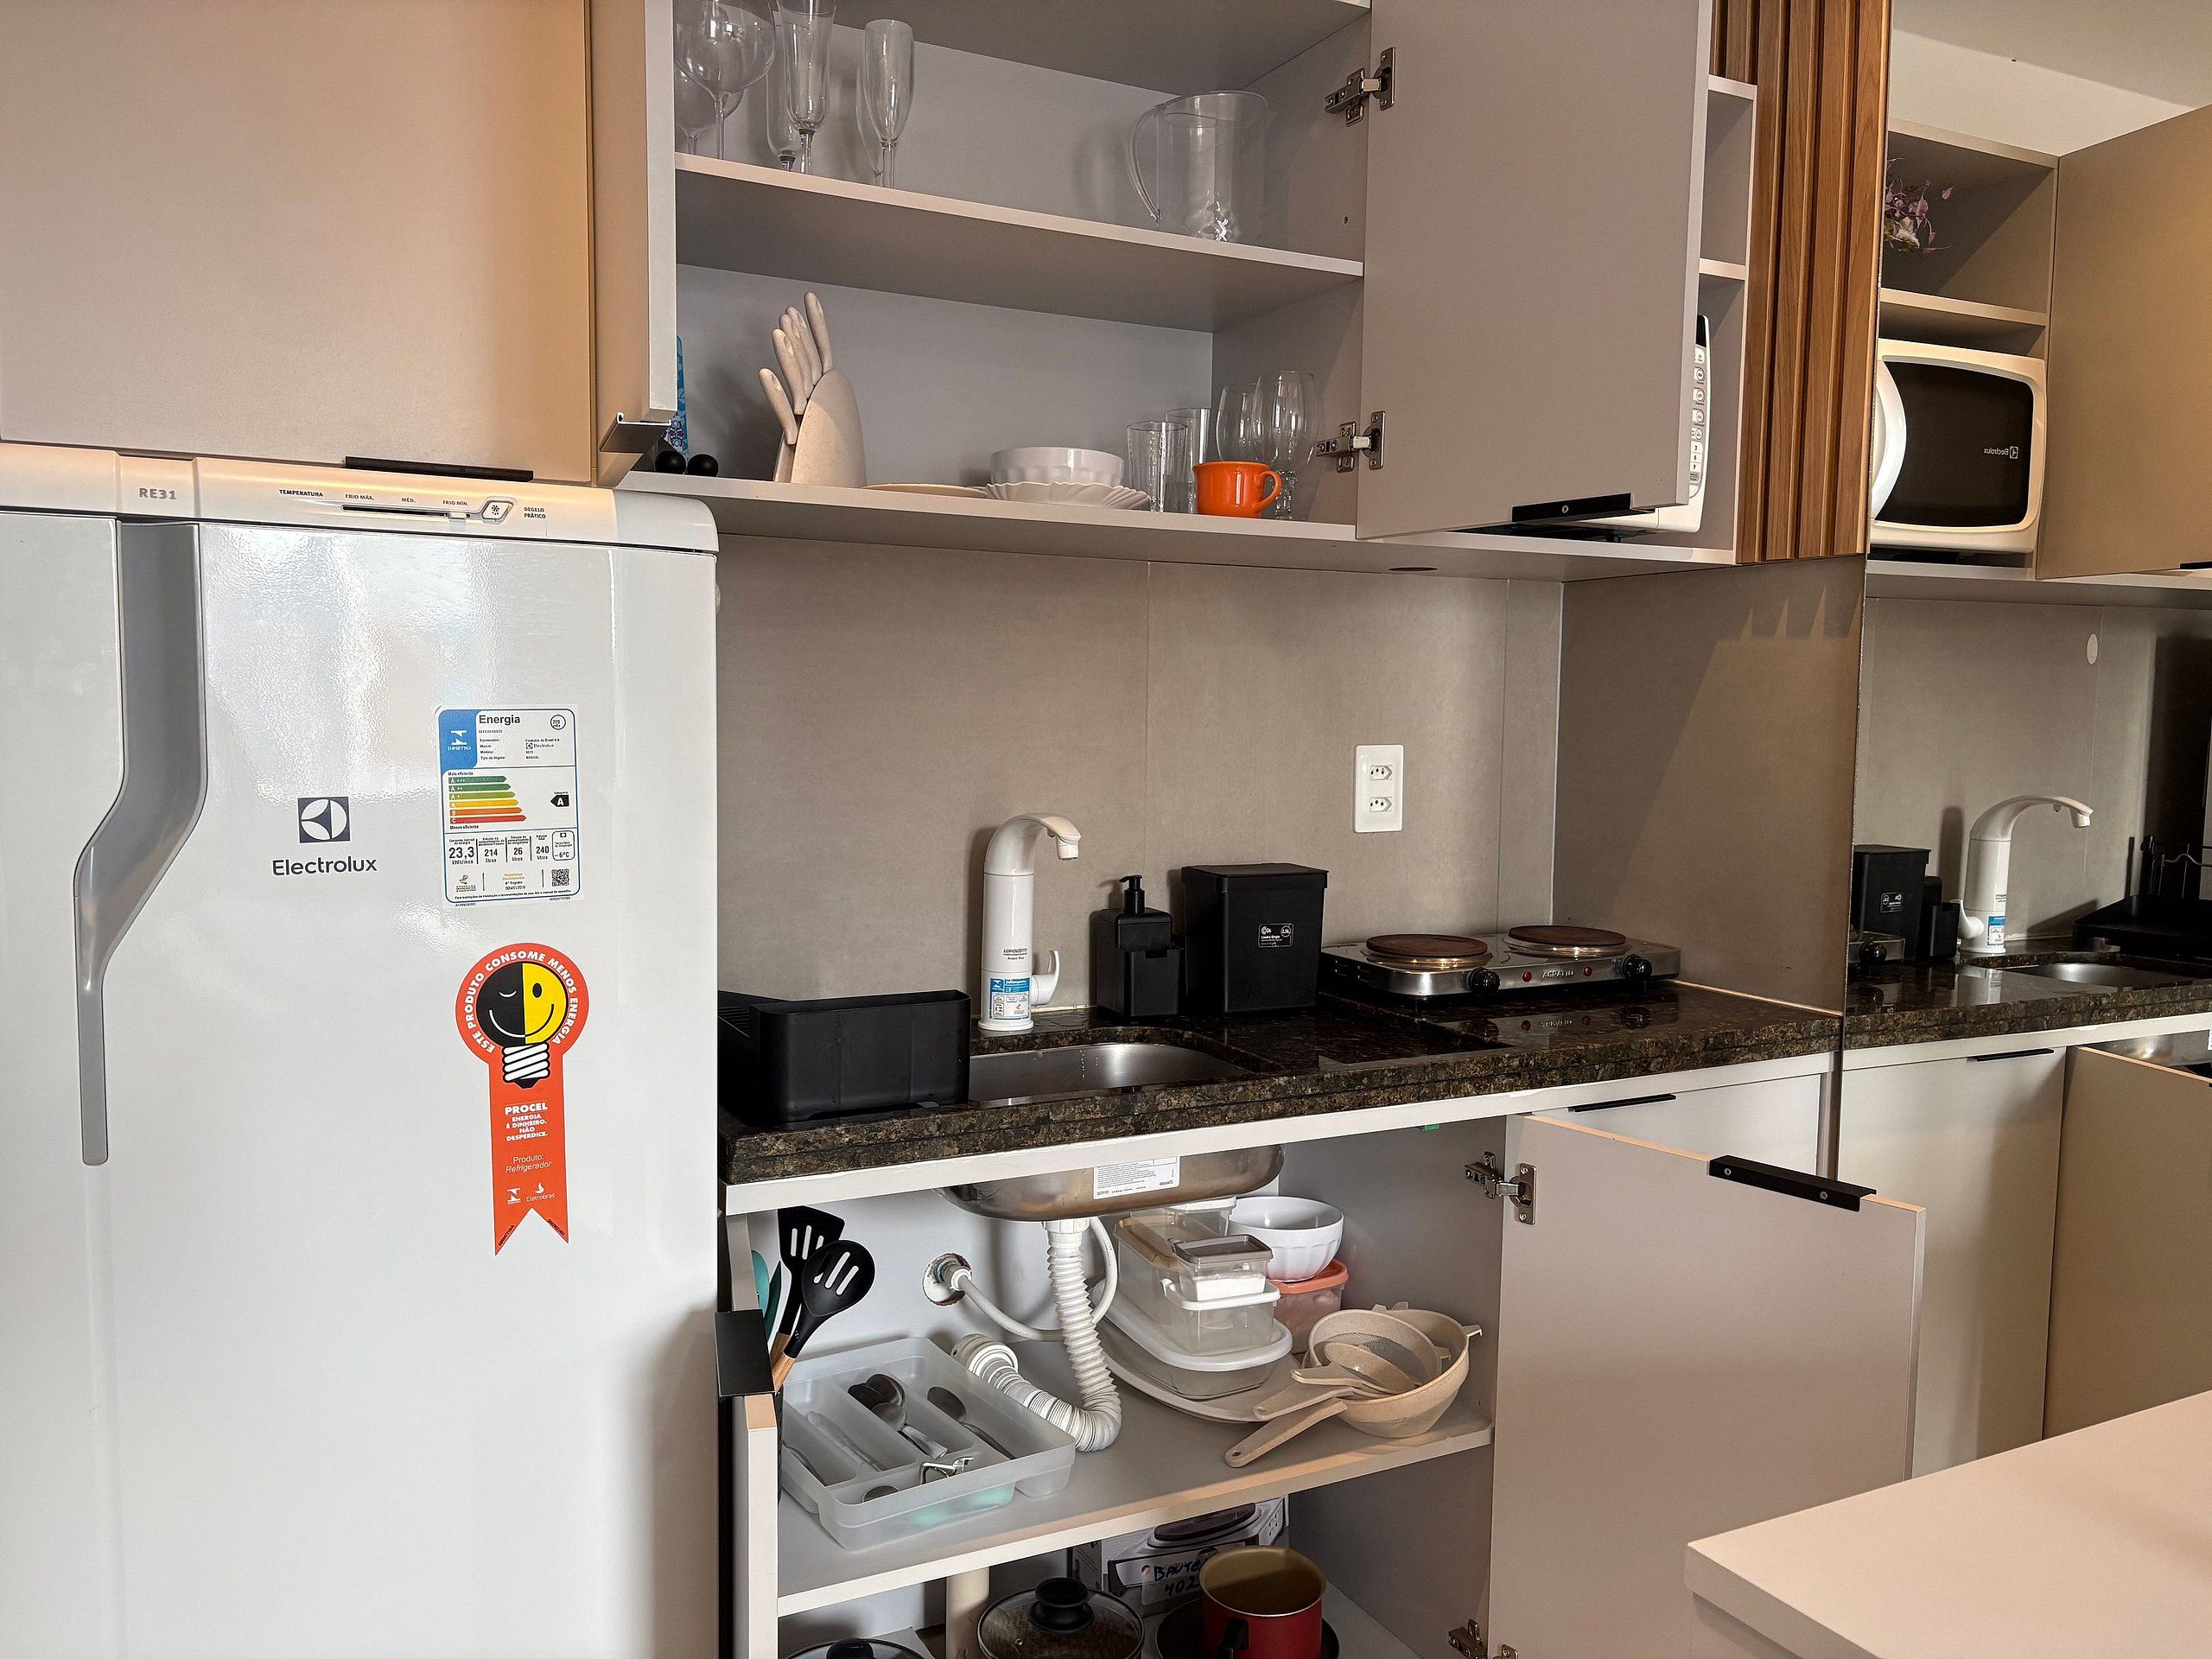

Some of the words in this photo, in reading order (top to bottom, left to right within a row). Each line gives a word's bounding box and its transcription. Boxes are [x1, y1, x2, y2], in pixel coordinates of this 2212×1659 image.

[139, 487, 176, 500] RE31
[279, 489, 323, 497] TEMPERATURA
[479, 714, 520, 726] Energia
[449, 846, 474, 860] 23,3
[536, 846, 549, 854] 240
[272, 856, 377, 876] Electrolux
[485, 950, 546, 972] CONSOME
[547, 958, 577, 993] MENOS
[464, 972, 484, 1030] PRODUTO
[552, 997, 578, 1045] ENERGIA
[472, 1031, 496, 1053] ESTE
[504, 1102, 548, 1115] PROCEL
[512, 1113, 542, 1122] ENERGIA
[512, 1119, 547, 1128] DINHEIRO.
[506, 1131, 548, 1141] DESPERDICE.
[513, 1154, 544, 1164] Produto:
[505, 1161, 552, 1173] Refrigerador
[526, 1193, 555, 1202] Eletrobras
